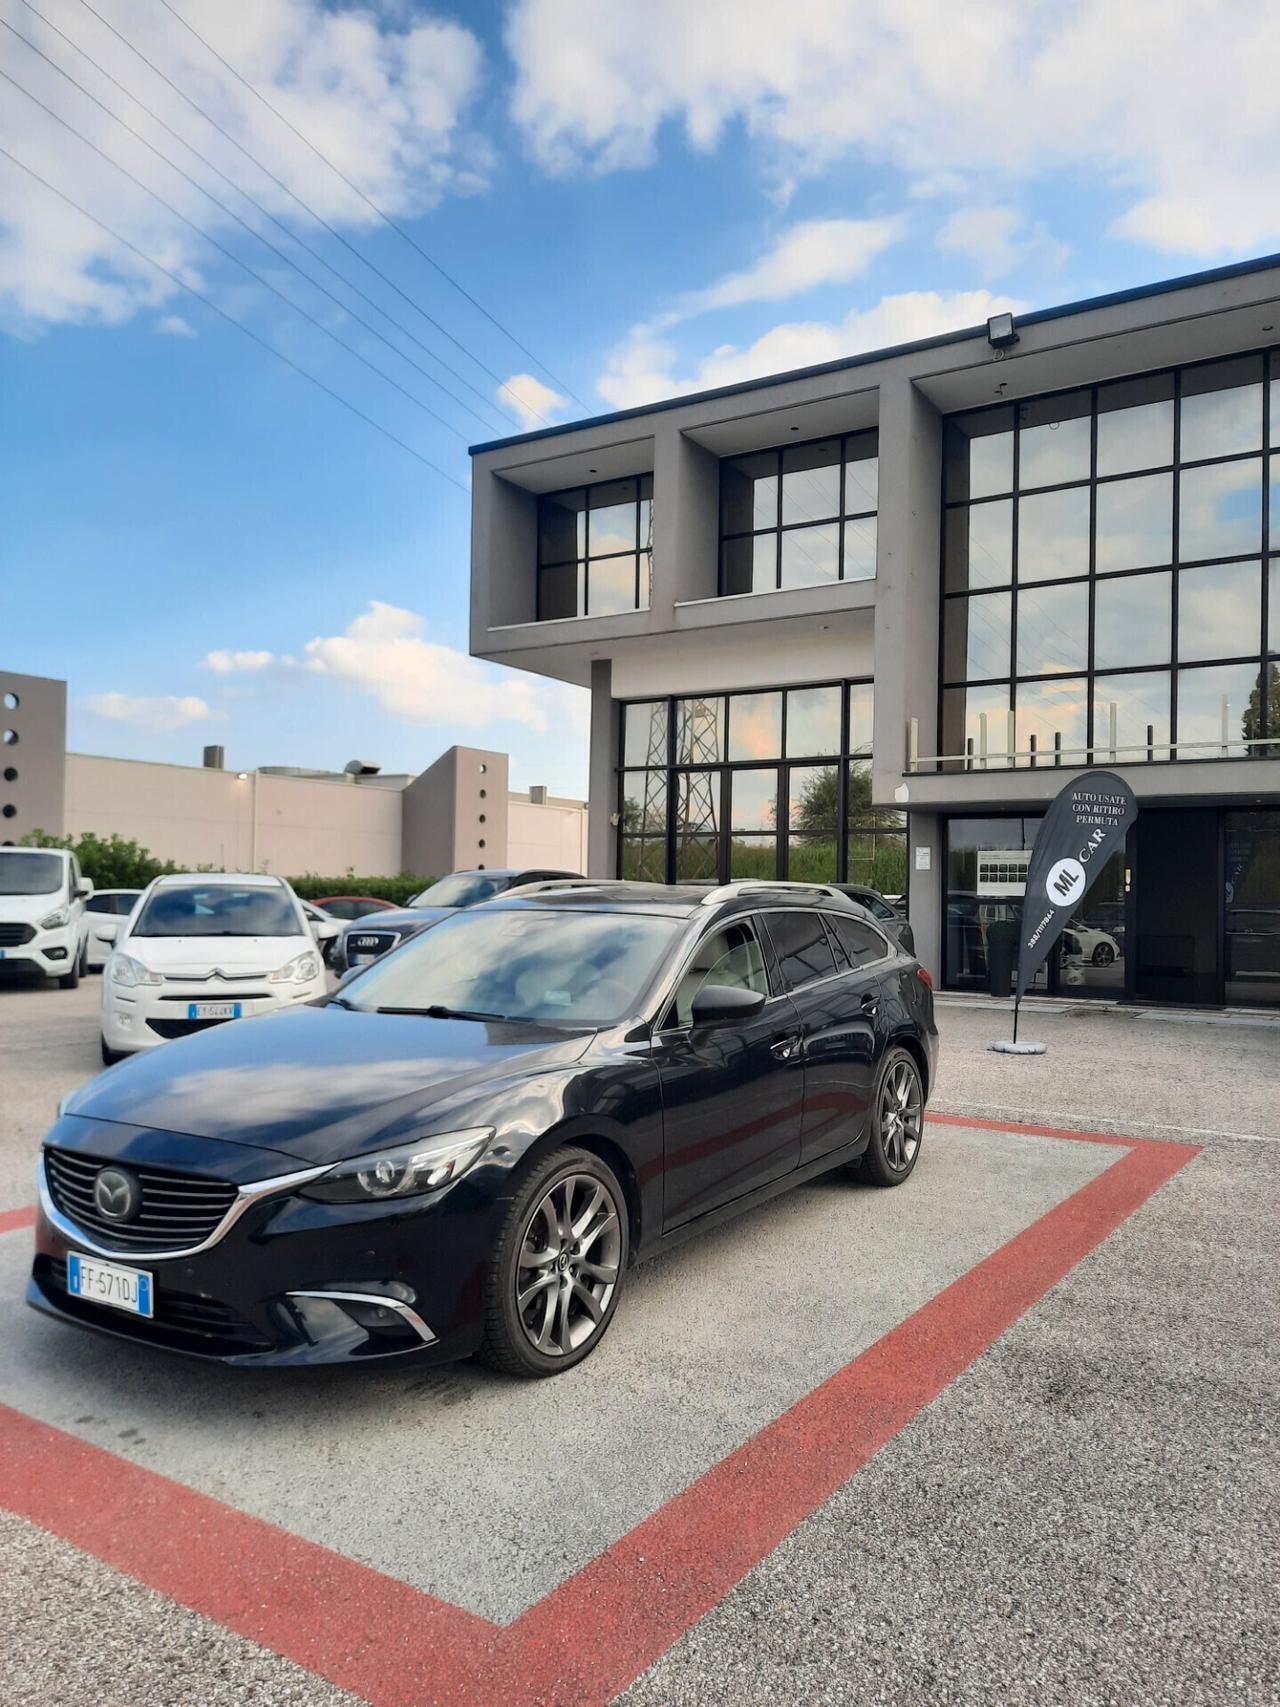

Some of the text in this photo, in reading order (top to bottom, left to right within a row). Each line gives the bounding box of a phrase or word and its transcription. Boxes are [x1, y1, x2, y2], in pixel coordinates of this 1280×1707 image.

[1072, 792, 1127, 805] AUTO USATE
[1072, 803, 1125, 816] CON RITIRO
[1076, 814, 1118, 826] PERMUTA
[1053, 828, 1106, 897] ML CAR
